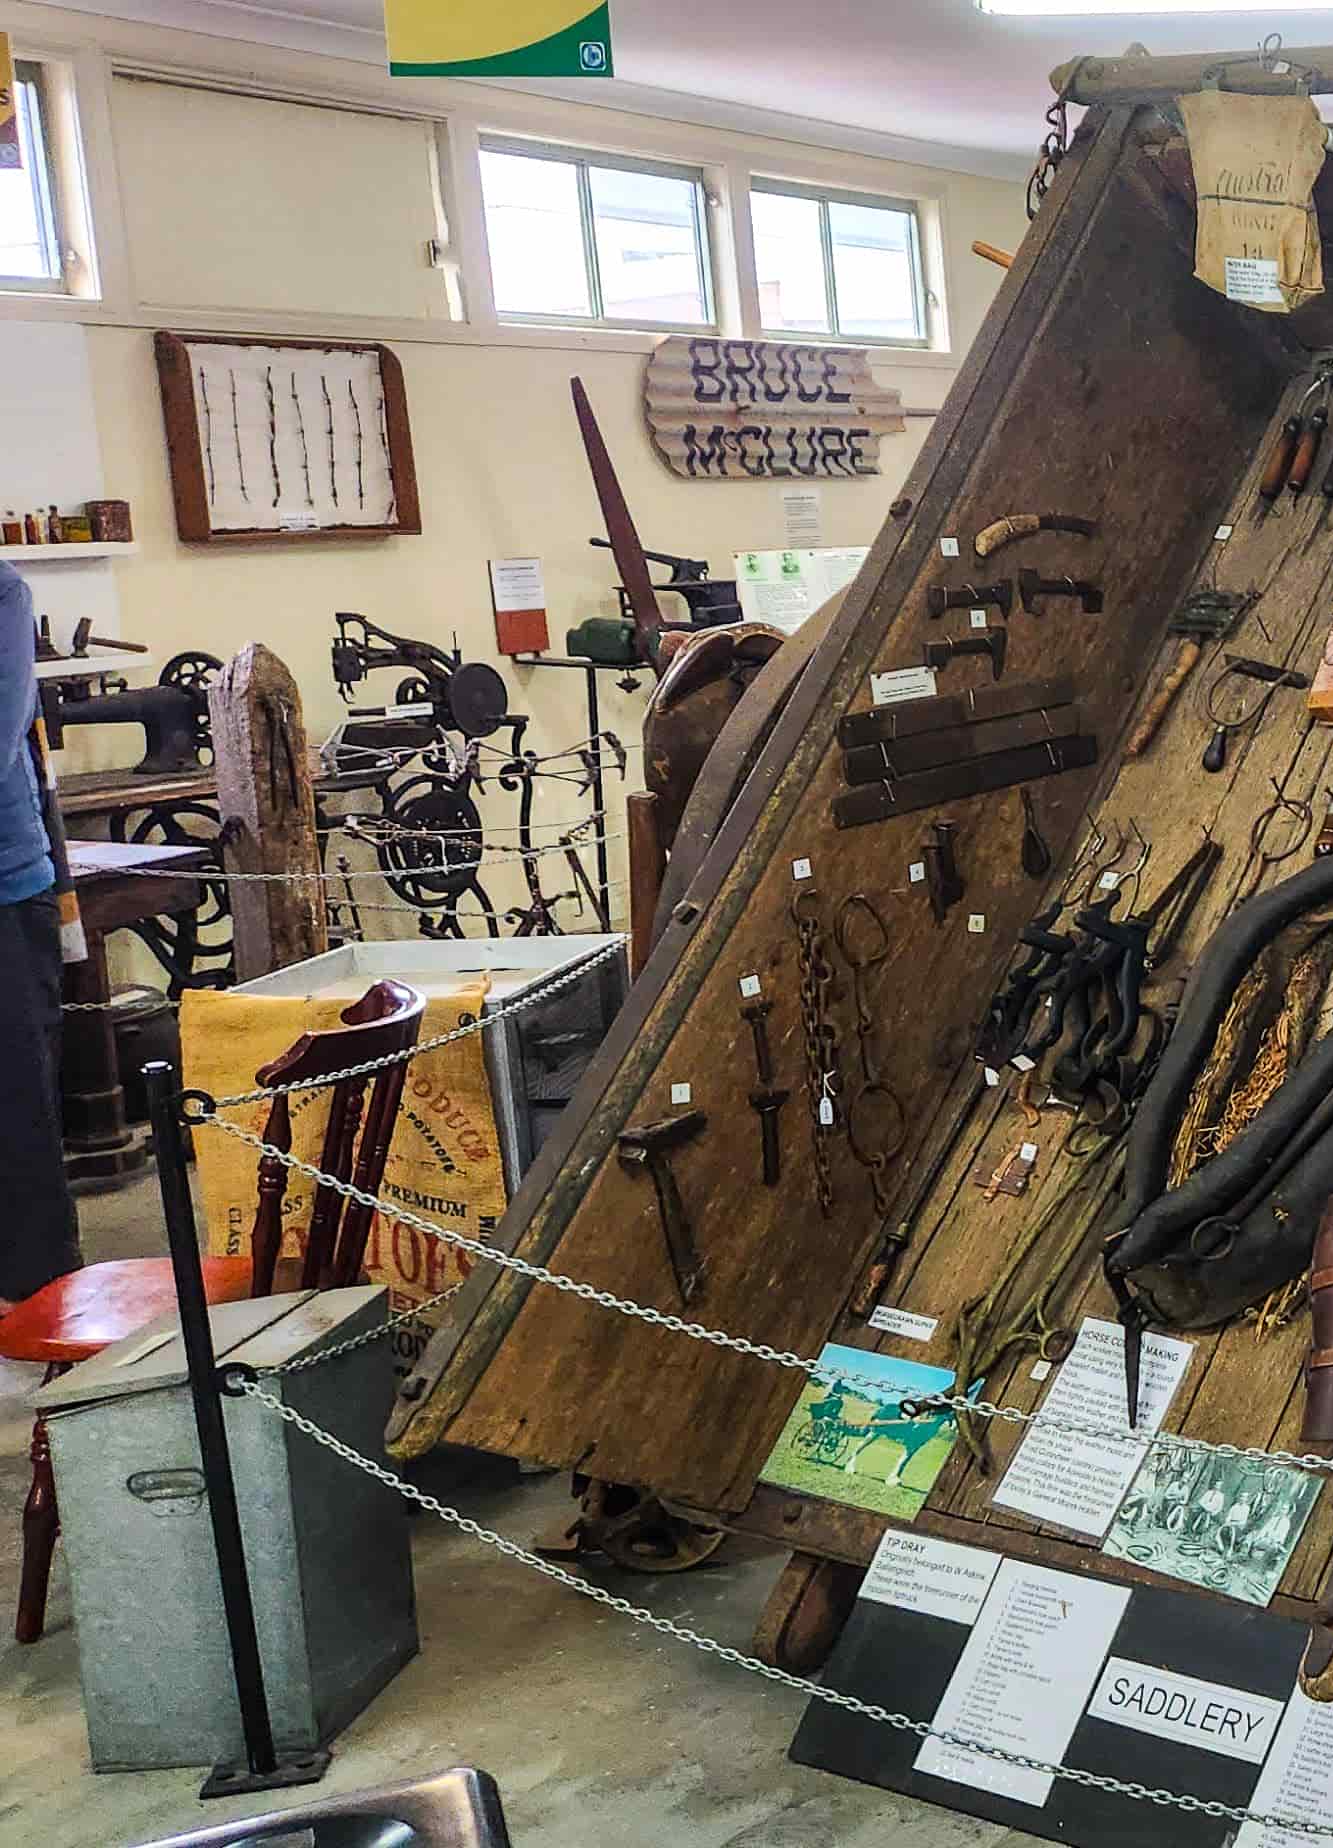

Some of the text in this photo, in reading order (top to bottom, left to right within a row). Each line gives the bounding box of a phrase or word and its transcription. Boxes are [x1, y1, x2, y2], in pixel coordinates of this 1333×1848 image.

[689, 338, 852, 403] BRUCE
[1079, 1328, 1111, 1344] HORSE
[1143, 1345, 1181, 1362] MAKING
[899, 1539, 927, 1554] DRAY
[1108, 1677, 1264, 1743] SADDLERY
